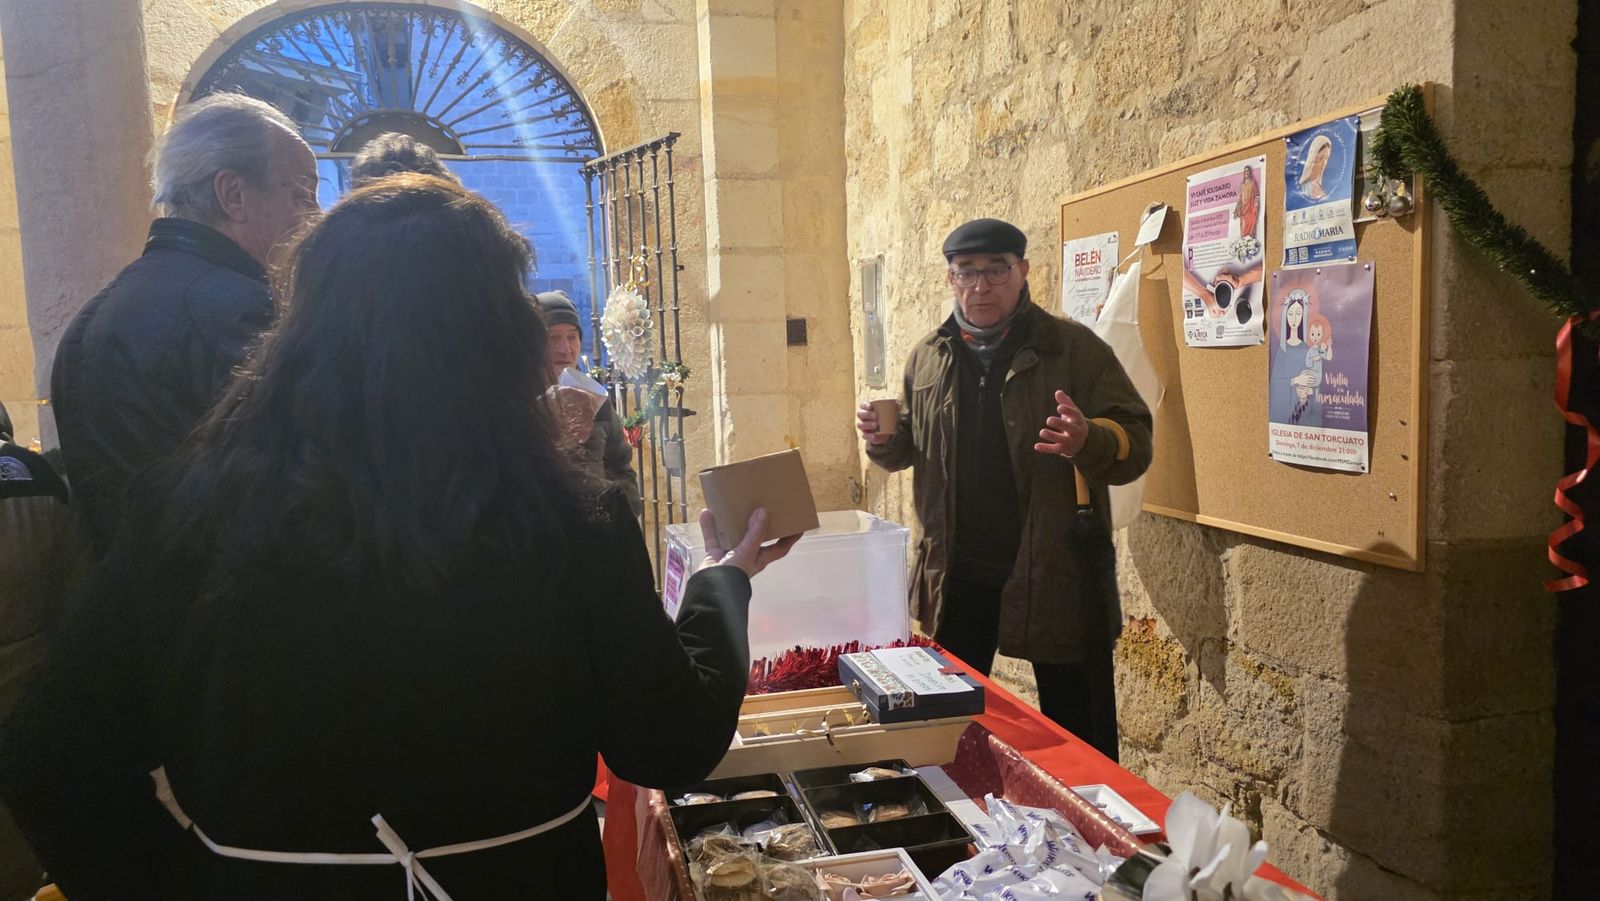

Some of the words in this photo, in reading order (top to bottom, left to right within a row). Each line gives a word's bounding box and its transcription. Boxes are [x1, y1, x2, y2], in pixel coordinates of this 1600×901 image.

[1196, 187, 1206, 198] CAFÉ
[1206, 182, 1232, 195] SOLIDARIO
[1190, 200, 1199, 208] LUZ
[1203, 196, 1215, 205] VIDA
[1215, 191, 1238, 201] ZAMORA
[1295, 229, 1317, 242] RADIO
[1318, 226, 1344, 239] MARIA
[1075, 248, 1102, 267] BELÉN
[1074, 266, 1102, 277] NAVIDEÑO
[1325, 372, 1349, 388] Vigilia
[1315, 388, 1364, 407] Inmaculada
[1271, 429, 1293, 438] IGLESIA
[1293, 431, 1303, 440] DE
[1304, 432, 1320, 441] SAN
[1321, 434, 1365, 446] TORCUATO
[1308, 443, 1337, 453] diciembre
